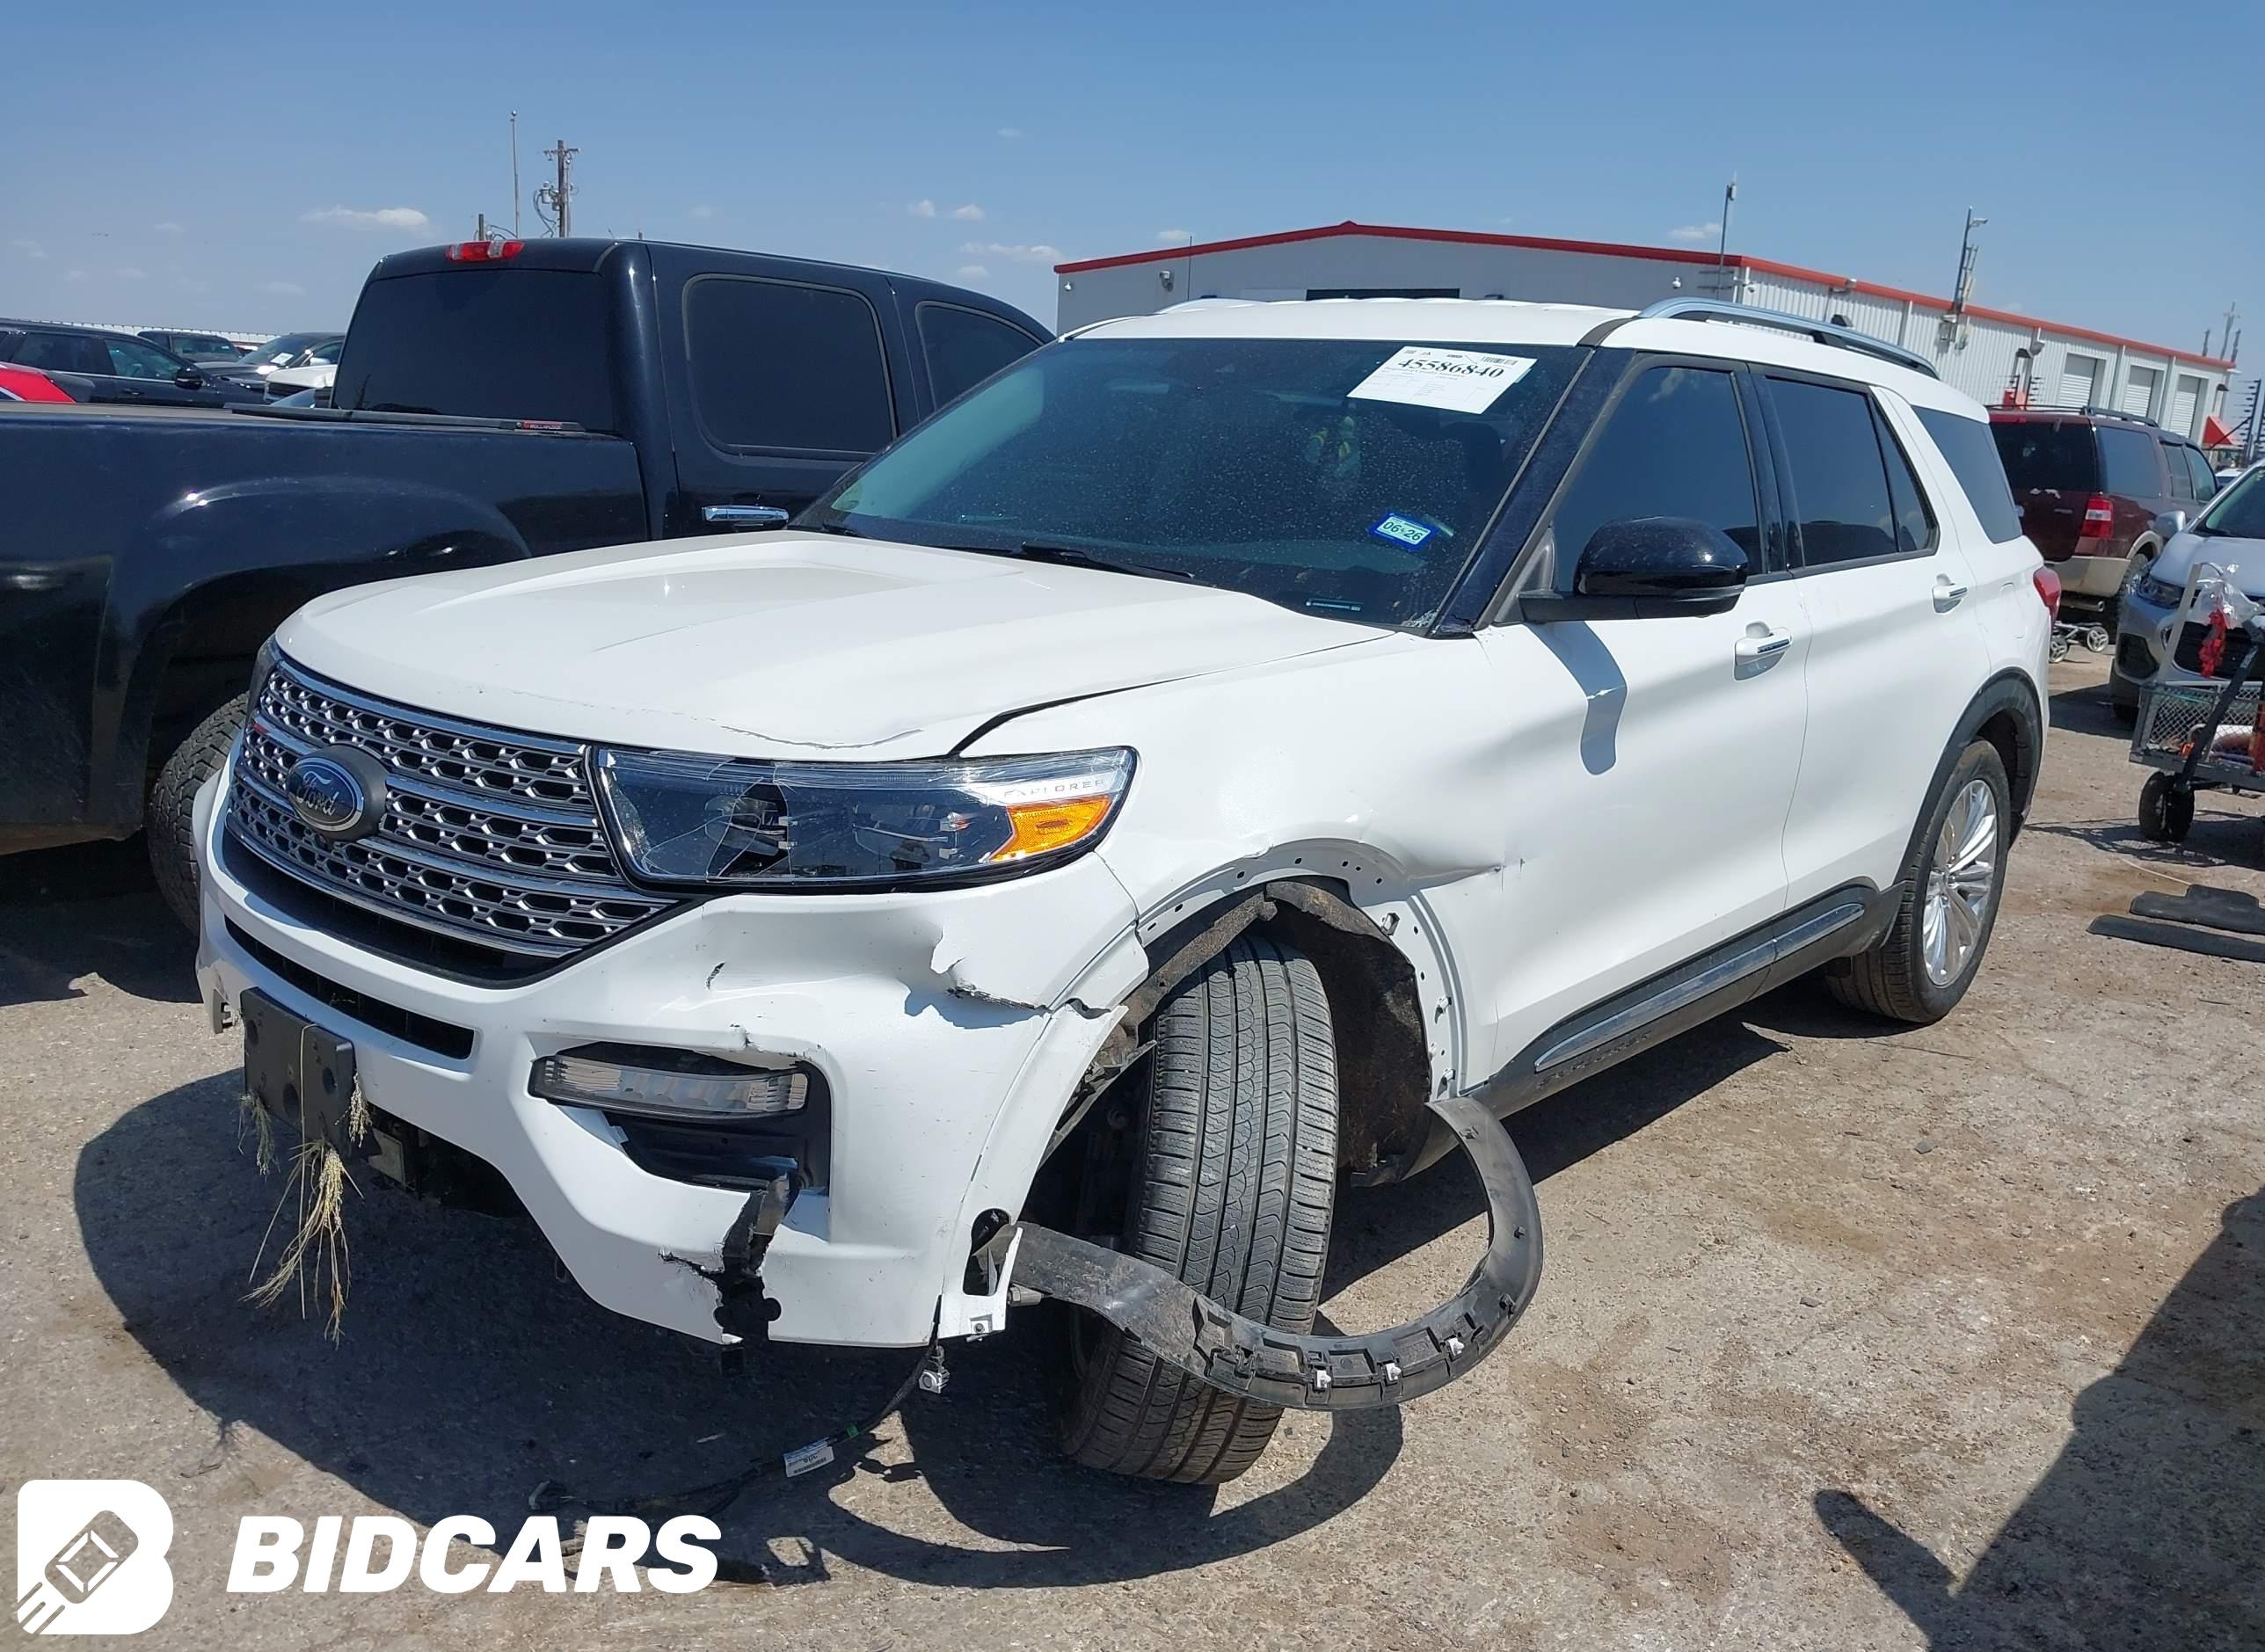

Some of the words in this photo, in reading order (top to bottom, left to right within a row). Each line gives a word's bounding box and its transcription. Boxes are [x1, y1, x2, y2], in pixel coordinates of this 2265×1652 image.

[1397, 358, 1504, 379] 45586840
[1382, 521, 1402, 533] 06
[1403, 529, 1423, 541] 26
[296, 770, 339, 816] Ford
